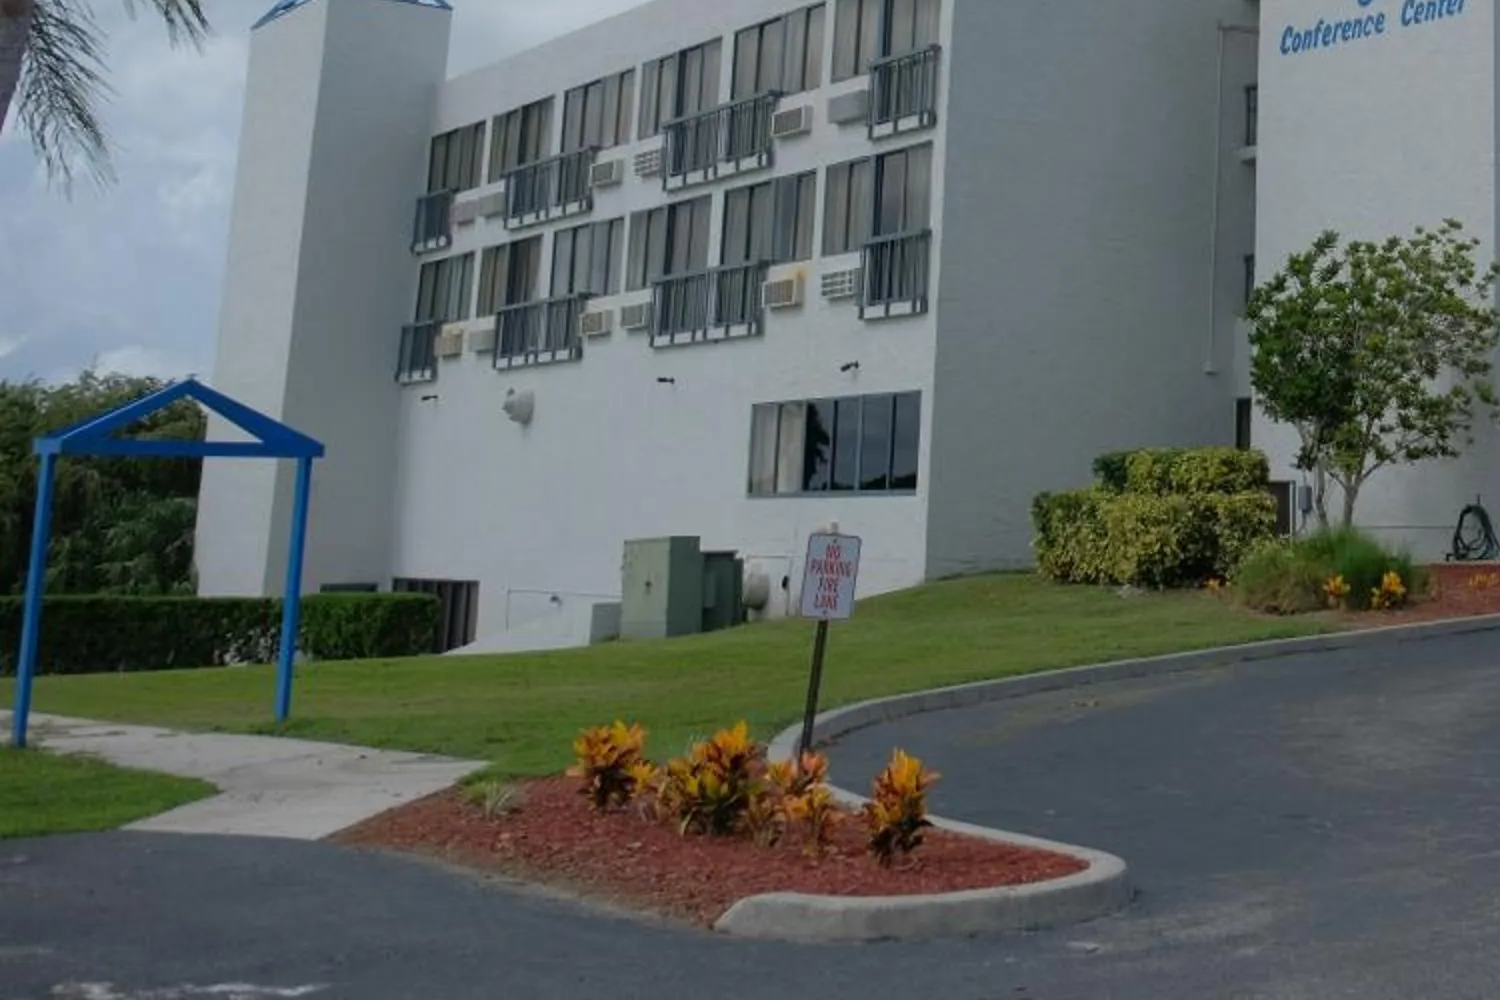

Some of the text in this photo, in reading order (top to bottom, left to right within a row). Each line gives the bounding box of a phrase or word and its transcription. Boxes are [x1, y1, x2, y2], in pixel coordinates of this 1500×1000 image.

[1280, 10, 1386, 56] Conference
[825, 544, 841, 559] NO
[811, 558, 852, 578] PARKING
[817, 577, 840, 594] FIRE
[814, 593, 839, 612] LANE
